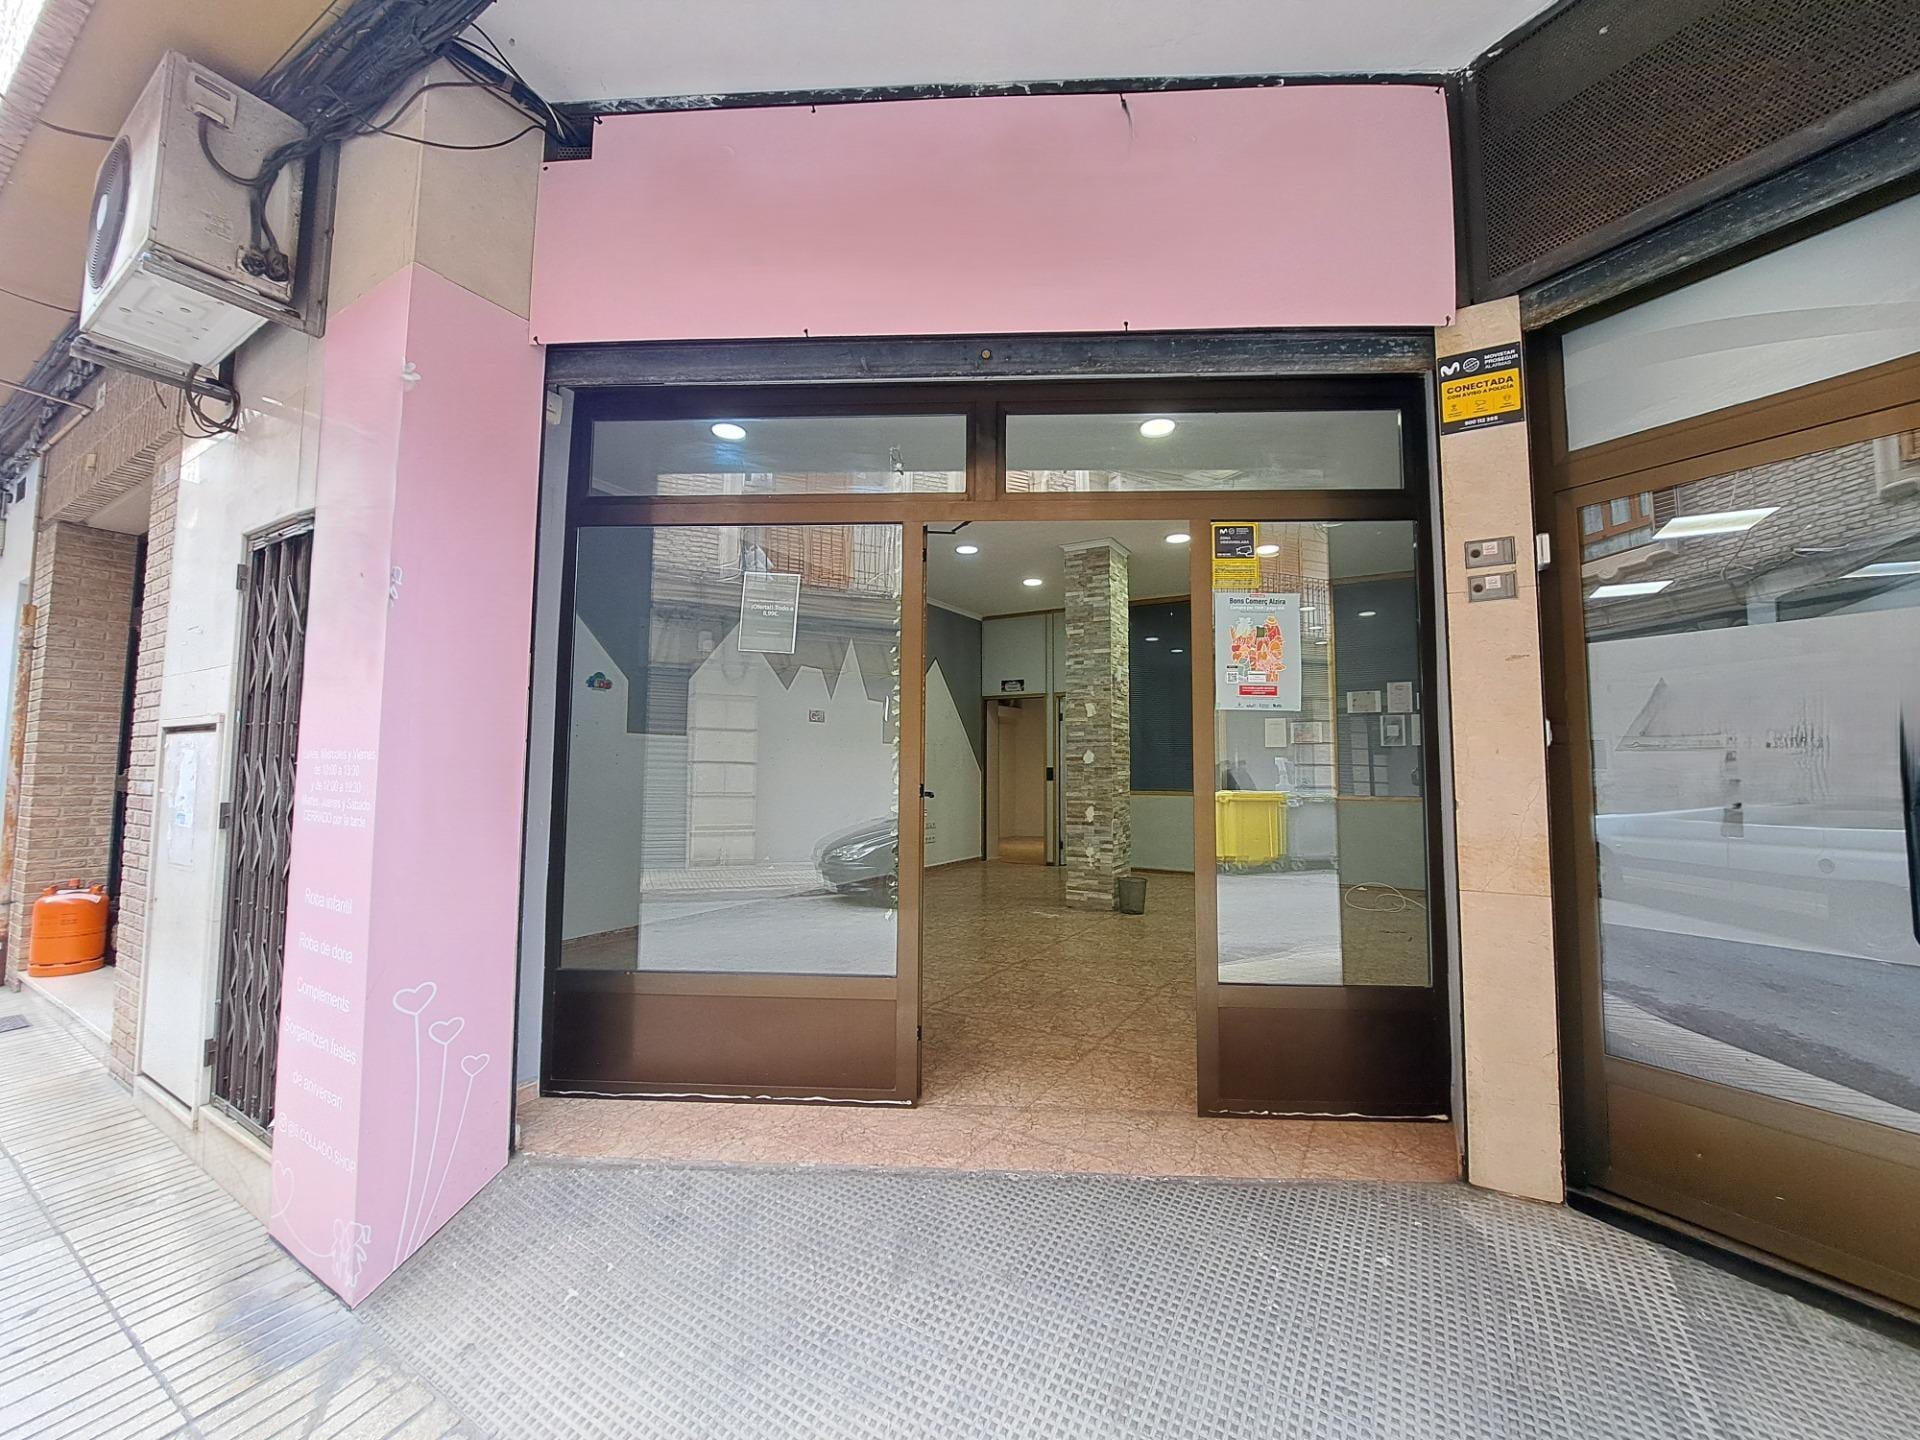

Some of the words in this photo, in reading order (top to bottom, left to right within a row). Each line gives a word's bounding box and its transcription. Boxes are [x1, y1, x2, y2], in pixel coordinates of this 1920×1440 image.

[1484, 349, 1515, 359] MOVISTAR
[1484, 353, 1519, 364] PROSEGUR
[1447, 376, 1514, 394] CONECTADA
[1245, 597, 1268, 606] Comerç
[331, 944, 353, 964] dona
[297, 976, 351, 1012] Complements
